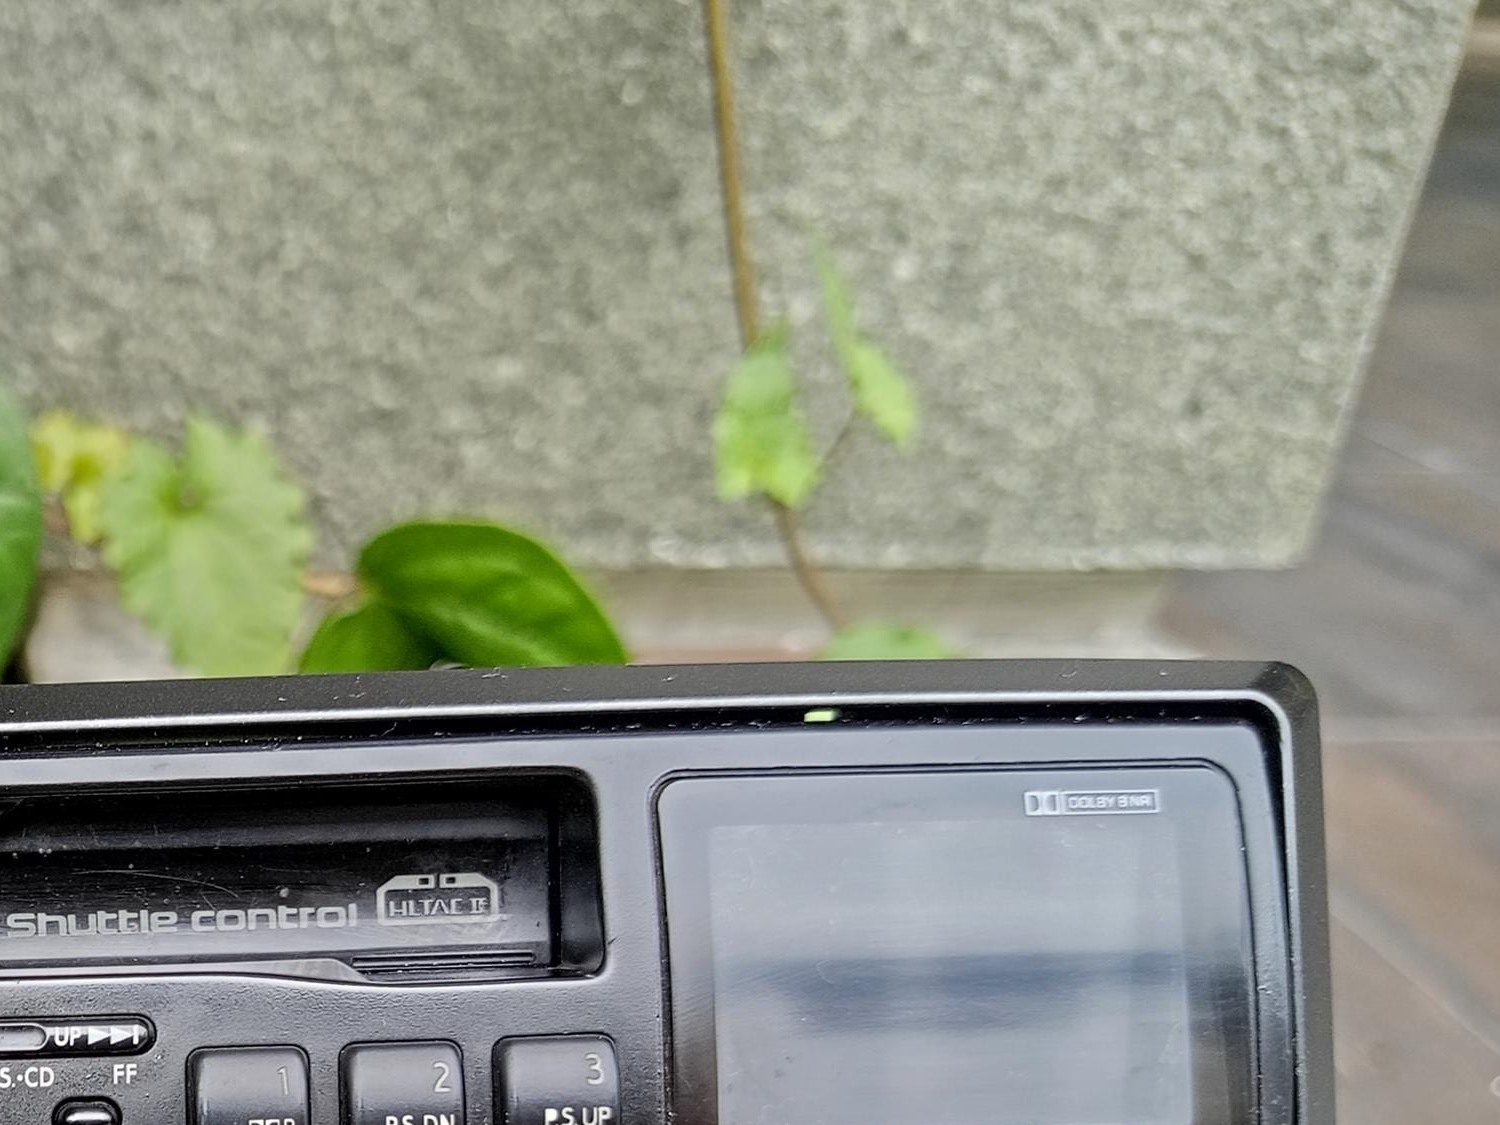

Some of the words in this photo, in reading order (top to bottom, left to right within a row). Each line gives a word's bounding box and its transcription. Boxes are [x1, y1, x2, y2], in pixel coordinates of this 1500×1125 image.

[54, 1026, 82, 1047] UP
[113, 1063, 137, 1085] FF
[276, 1066, 290, 1096] 1
[433, 1062, 452, 1093] 2
[585, 1054, 605, 1085] 3
